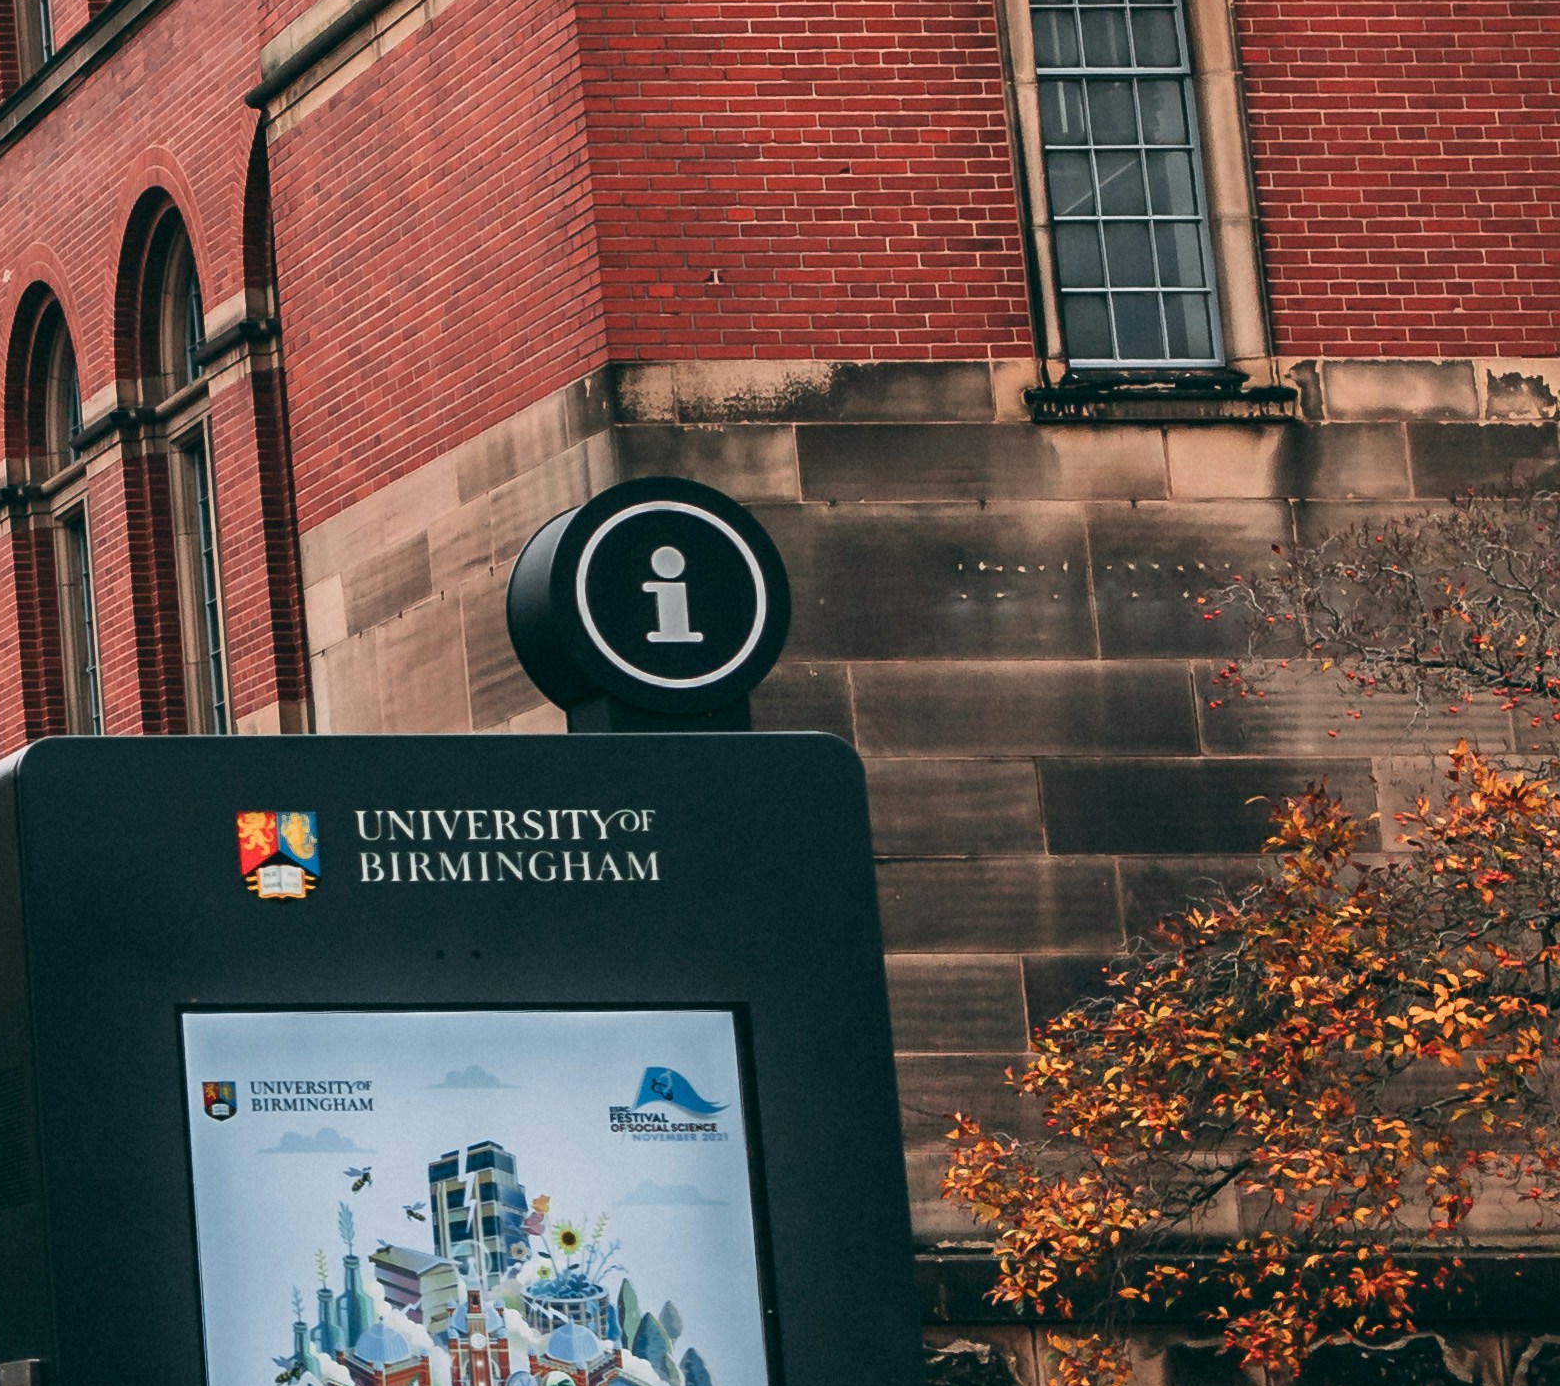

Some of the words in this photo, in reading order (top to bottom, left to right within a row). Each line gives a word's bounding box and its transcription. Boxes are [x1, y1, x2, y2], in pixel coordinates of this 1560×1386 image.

[355, 810, 616, 842] UNIVERSITY
[618, 809, 655, 833] OF
[360, 851, 660, 883] BIRMINGHAM
[250, 1081, 354, 1095] UNIVERSITY
[354, 1080, 372, 1091] OF
[251, 1097, 374, 1112] BIRMINGHAM
[610, 1113, 669, 1123] FESTIVAL
[611, 1123, 627, 1132] OF
[628, 1123, 670, 1132] SOCIAL
[671, 1123, 717, 1132] SCIENCE
[633, 1133, 697, 1141] NOVEMBER
[701, 1132, 729, 1141] 2021
